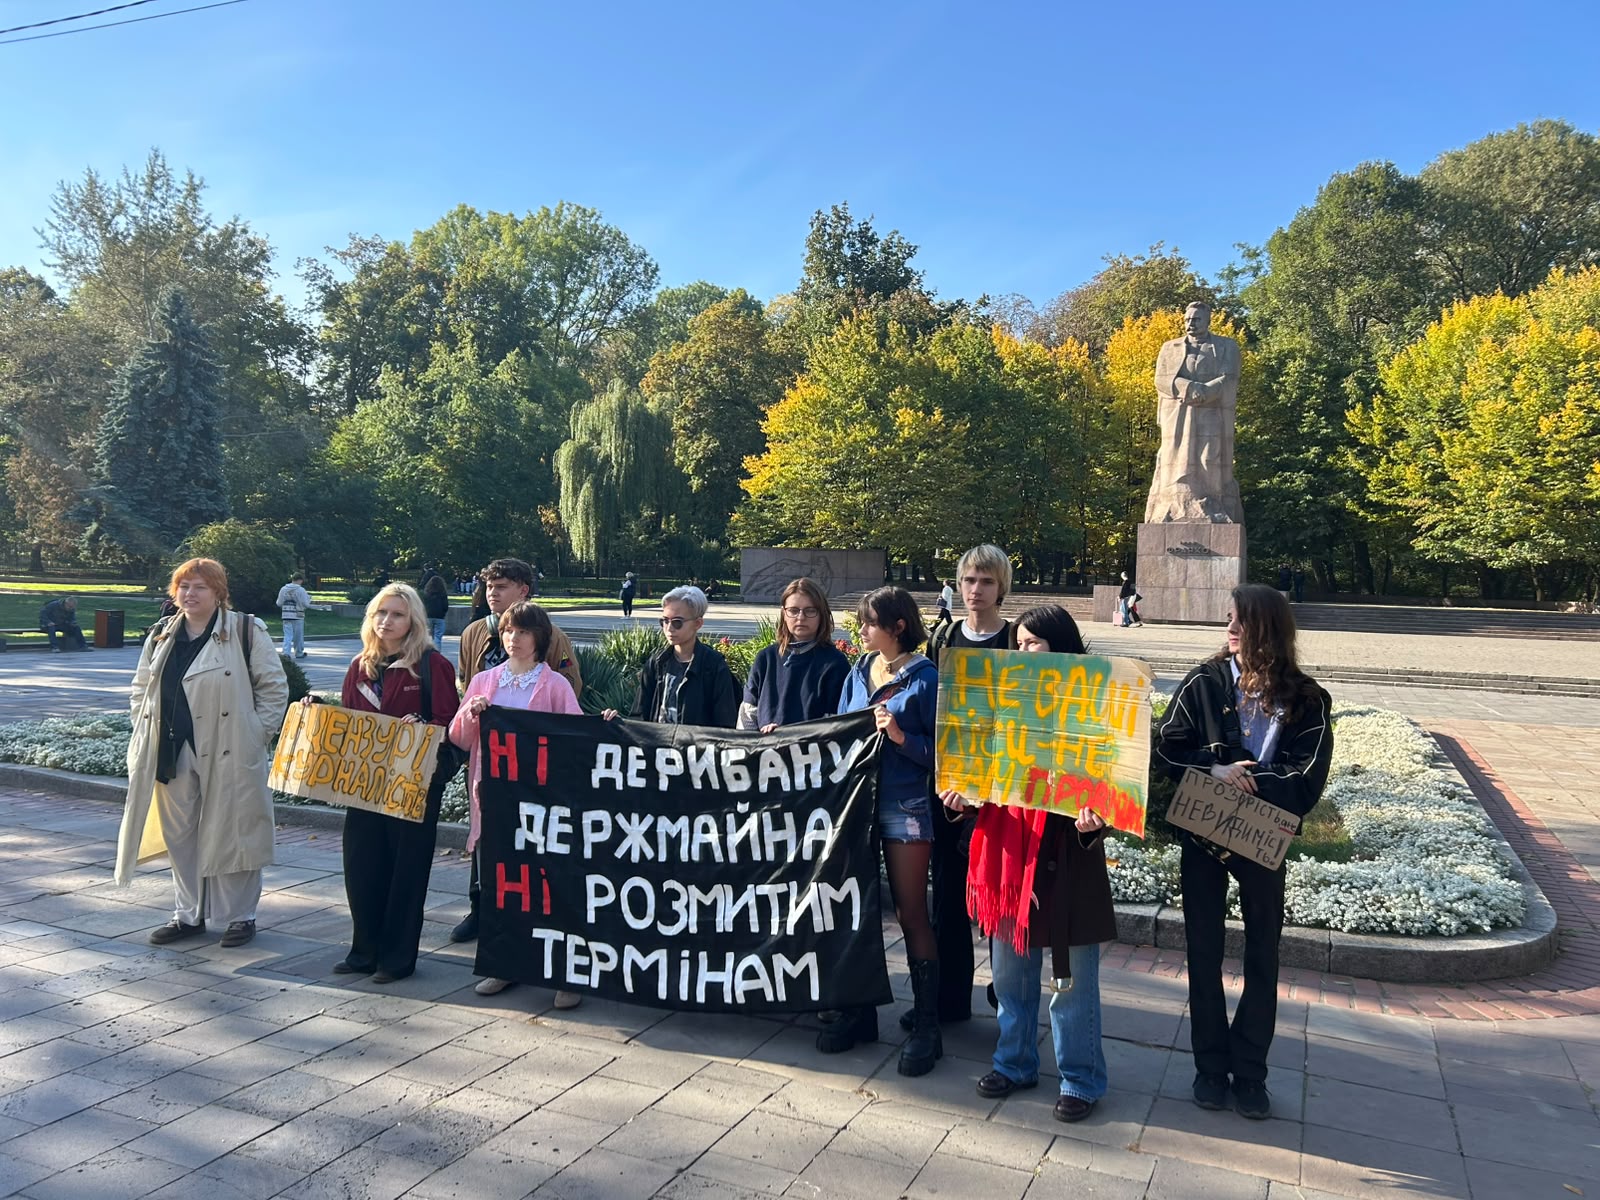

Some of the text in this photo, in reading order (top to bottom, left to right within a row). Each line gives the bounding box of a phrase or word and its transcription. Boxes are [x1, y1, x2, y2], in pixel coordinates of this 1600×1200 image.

[954, 653, 1026, 710] НЕ
[591, 738, 864, 794] ДЕРИБАНУ
[514, 801, 834, 864] ДЕРЖМАЙНА
[585, 875, 862, 937] РОЗМИТИМ
